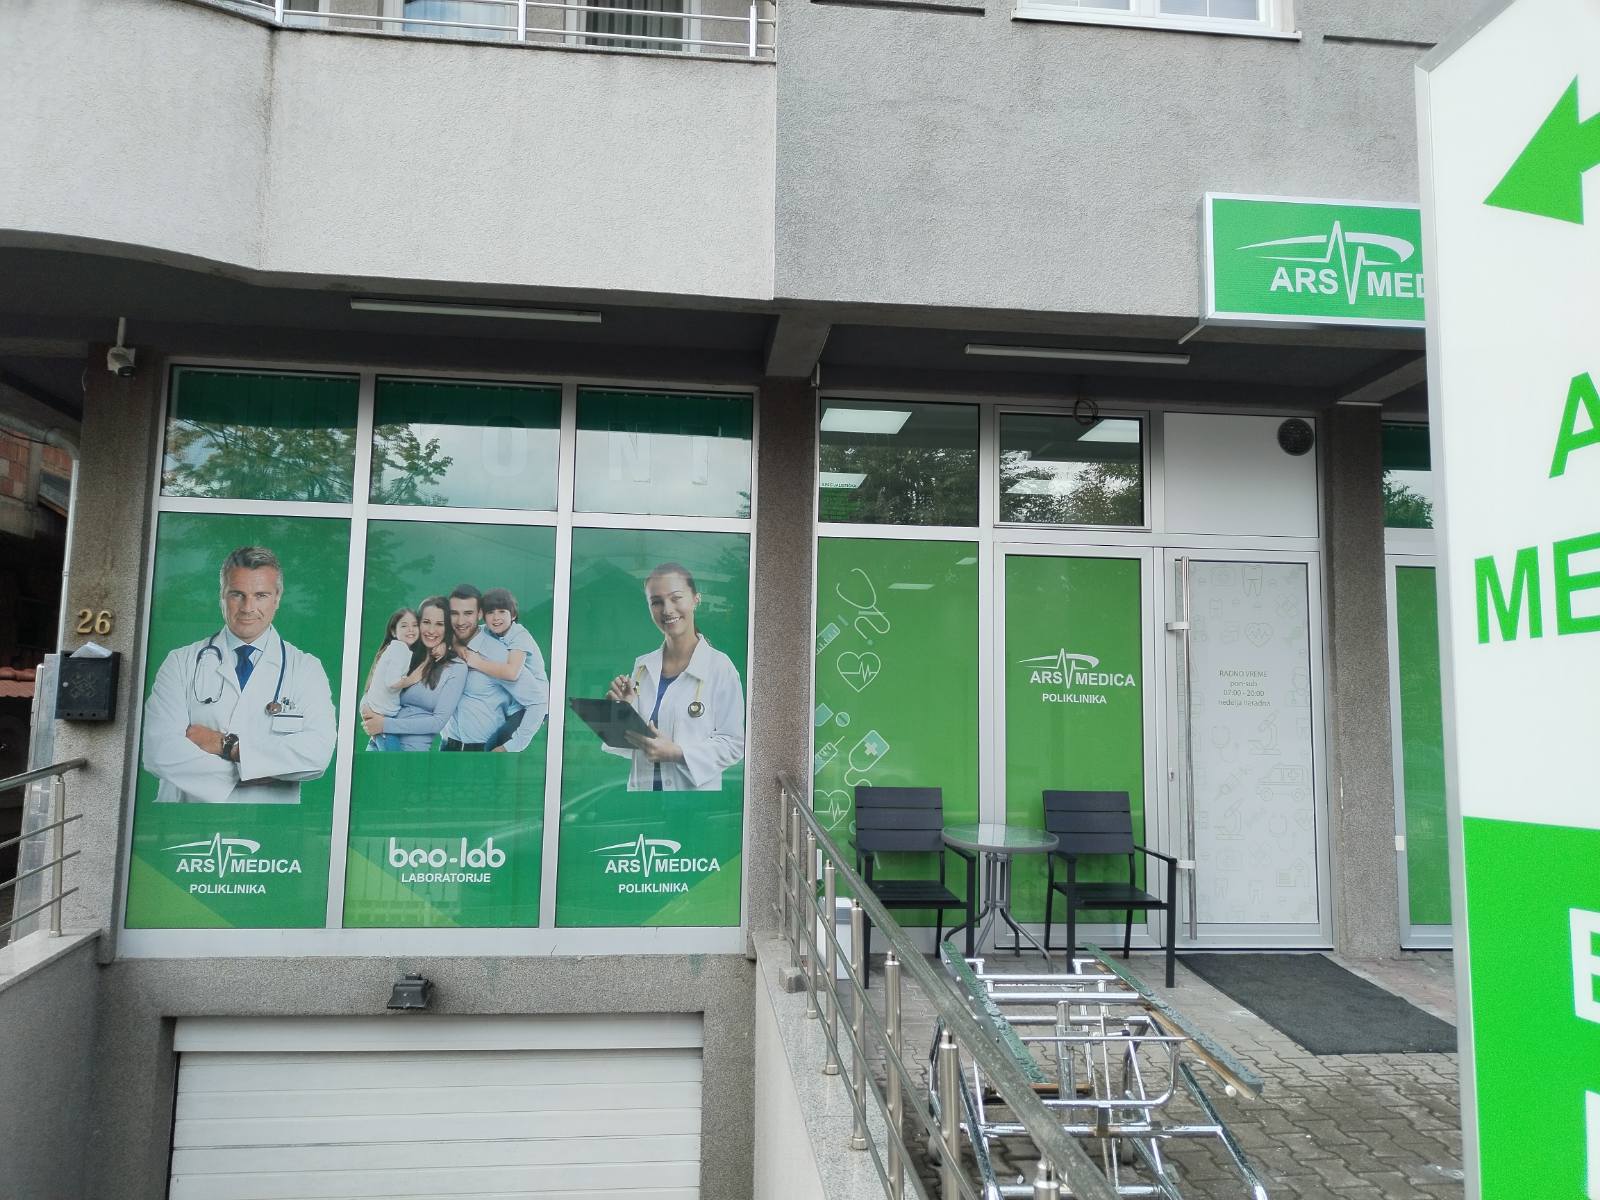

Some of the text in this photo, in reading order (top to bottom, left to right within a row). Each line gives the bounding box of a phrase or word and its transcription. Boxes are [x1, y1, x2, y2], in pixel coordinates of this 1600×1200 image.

[1269, 266, 1339, 295] ARS
[77, 608, 112, 635] 26
[1030, 670, 1136, 687] ARS MEDICA
[1219, 670, 1269, 678] RADNO VREME
[1042, 693, 1107, 704] POLIKLINIKA
[388, 836, 506, 868] beo-lab
[176, 858, 302, 874] ARS MEDICA
[604, 857, 721, 873] ARS MEDICA
[401, 872, 491, 883] LABORATORIJE
[189, 884, 267, 894] POLIKLINIKA
[618, 882, 689, 894] POLIKLINIKA
